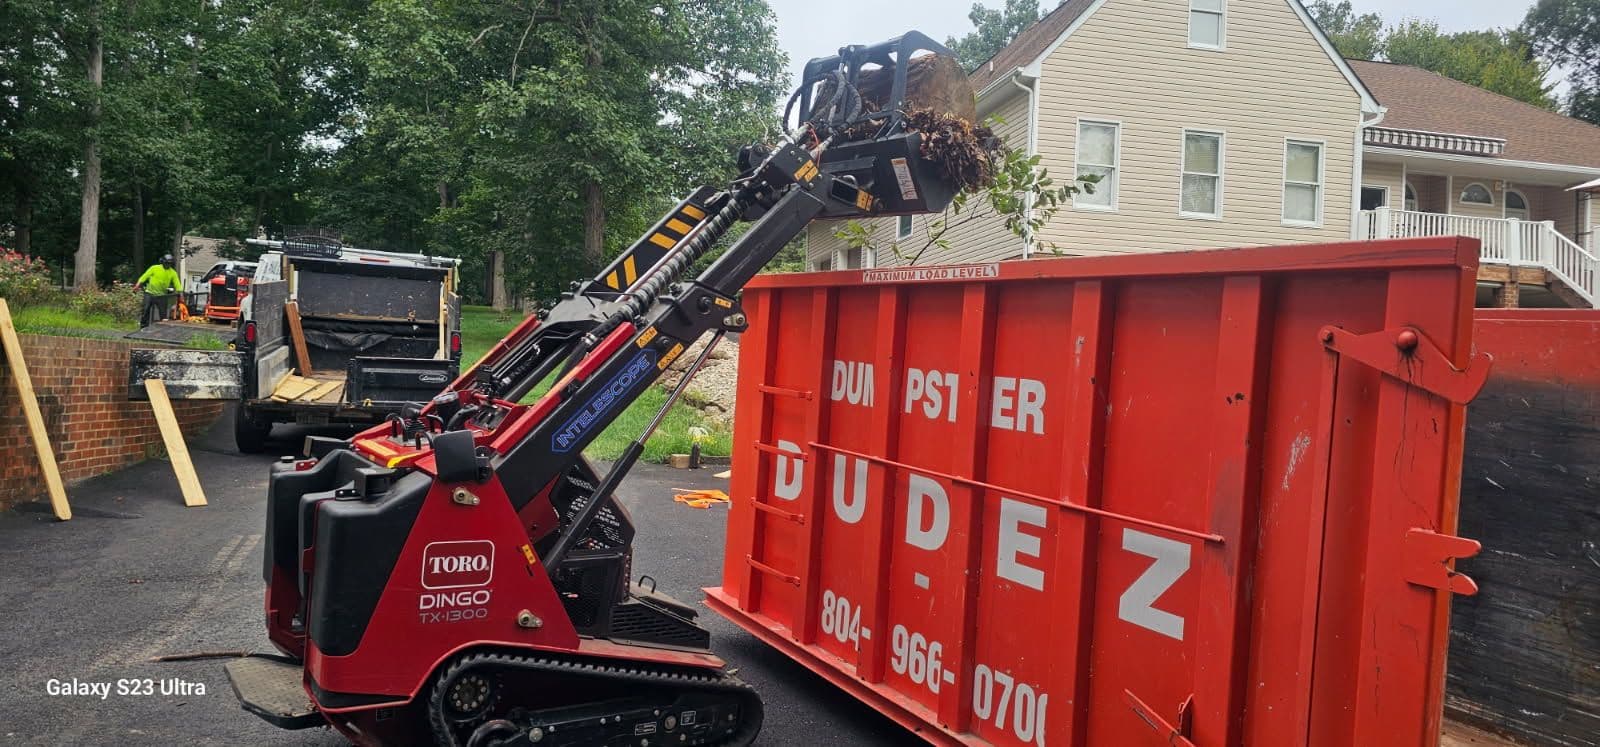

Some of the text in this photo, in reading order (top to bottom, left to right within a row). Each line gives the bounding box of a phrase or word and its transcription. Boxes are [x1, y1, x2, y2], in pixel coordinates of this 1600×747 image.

[869, 266, 990, 281] MAXIMUM LOAD LEVEL
[556, 356, 650, 448] INTELESCOPE
[429, 554, 488, 574] TORO
[419, 590, 490, 609] DINGO
